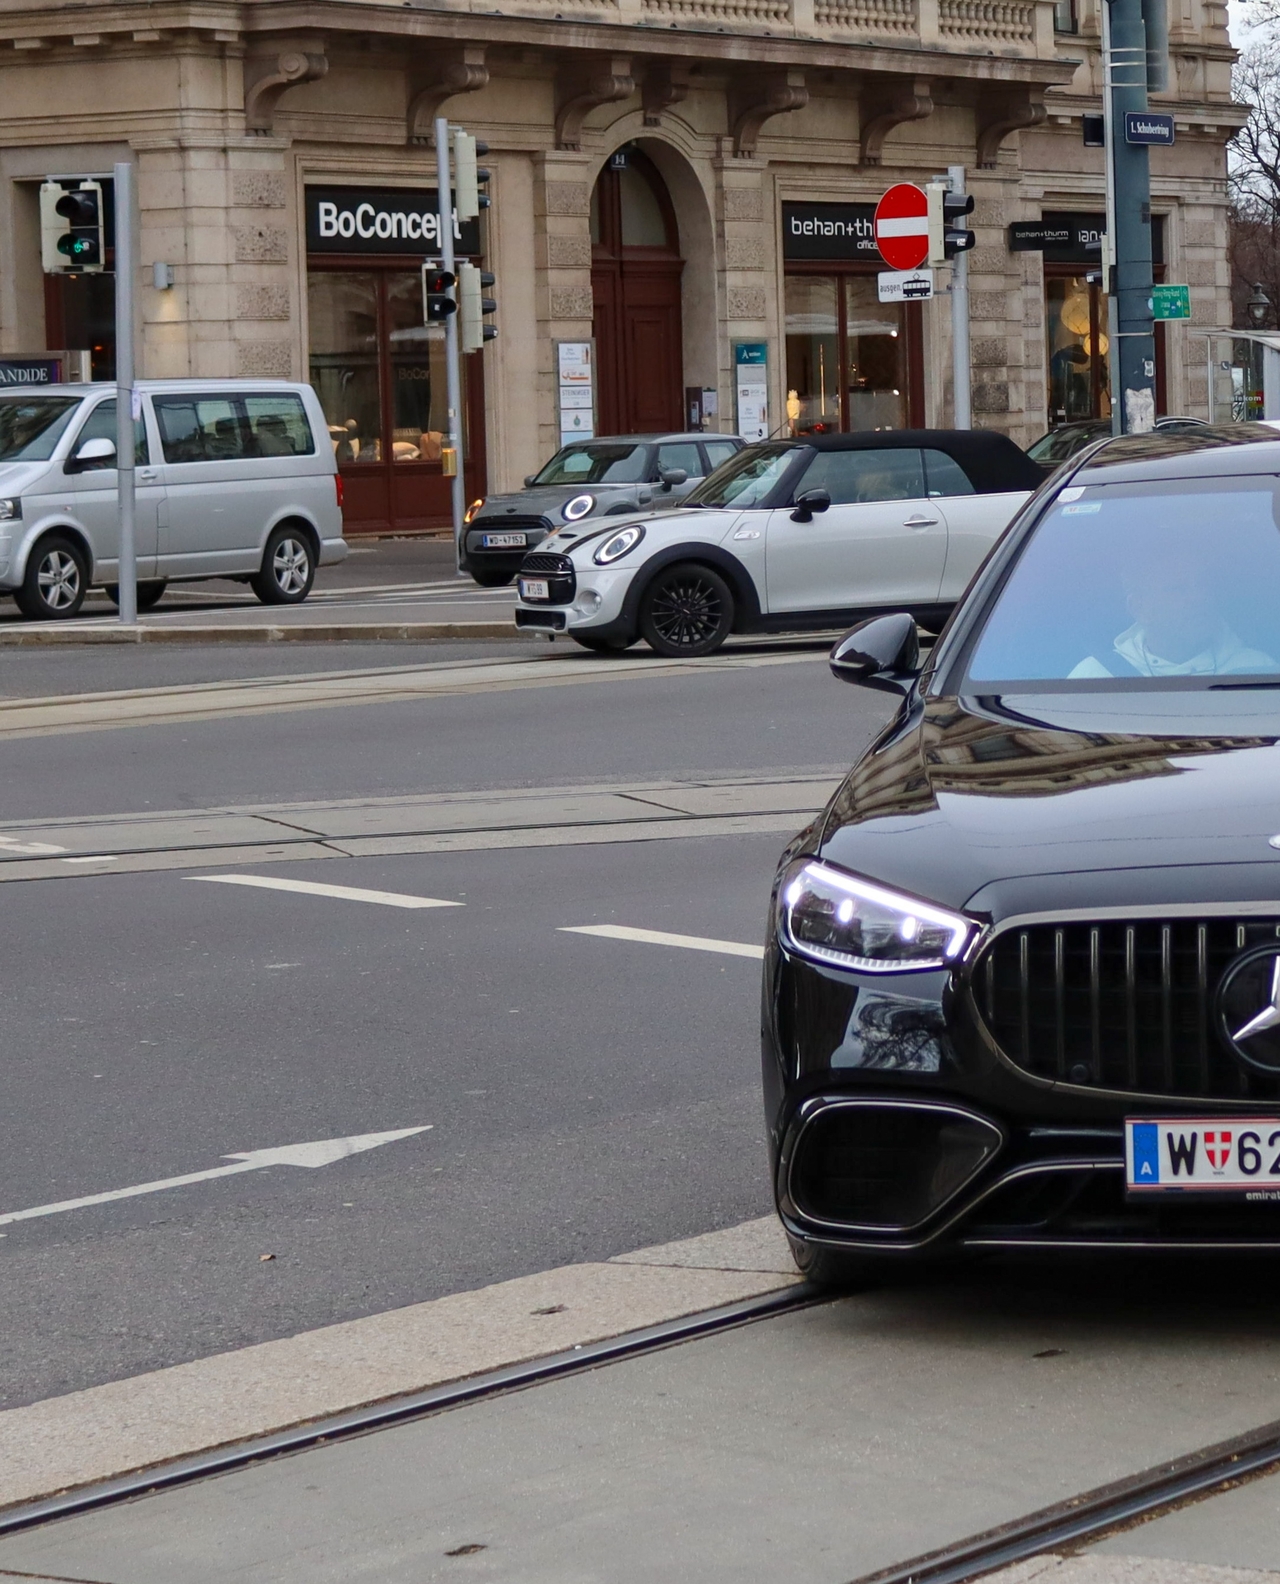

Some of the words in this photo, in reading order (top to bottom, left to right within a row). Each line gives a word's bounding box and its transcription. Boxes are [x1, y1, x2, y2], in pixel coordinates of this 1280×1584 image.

[1137, 121, 1169, 138] Schubertring
[1016, 230, 1069, 239] behan+thurm
[880, 282, 902, 294] ausgen.
[1140, 1161, 1153, 1175] A
[1167, 1132, 1198, 1176] W
